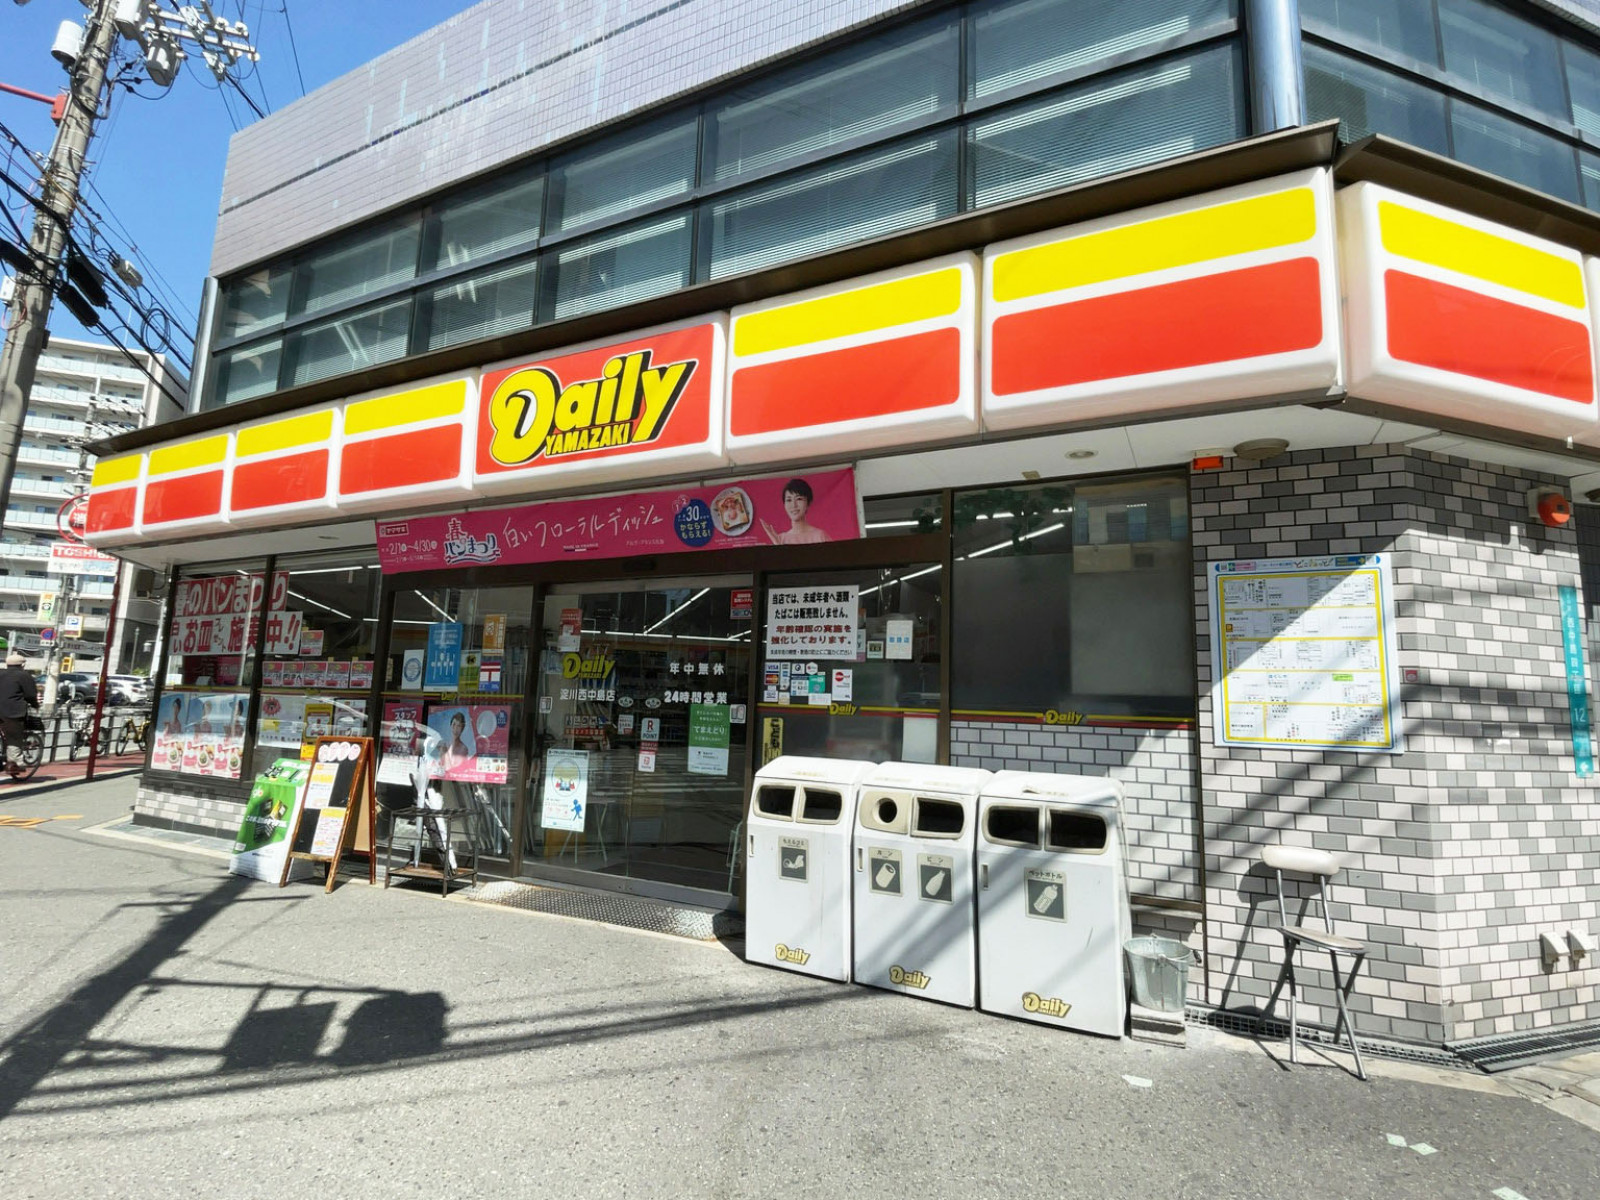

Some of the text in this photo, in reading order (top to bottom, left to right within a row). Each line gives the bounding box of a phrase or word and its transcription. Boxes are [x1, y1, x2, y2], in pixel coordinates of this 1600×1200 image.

[490, 350, 698, 464] Daily
[545, 422, 633, 456] YAMAZAKI
[503, 504, 663, 548] 白いフローラルディッシュ
[562, 652, 615, 679] Daily
[669, 663, 725, 675] 年中無休
[560, 688, 616, 701] 淀川西中島店
[664, 690, 728, 704] 24時間営業
[829, 703, 857, 715] Daily
[1045, 709, 1083, 725] Daily
[1574, 708, 1586, 722] 12
[1028, 870, 1063, 879] ペットボトル
[775, 943, 811, 965] Daily
[889, 965, 931, 989] Daily
[1022, 991, 1072, 1018] Daily
